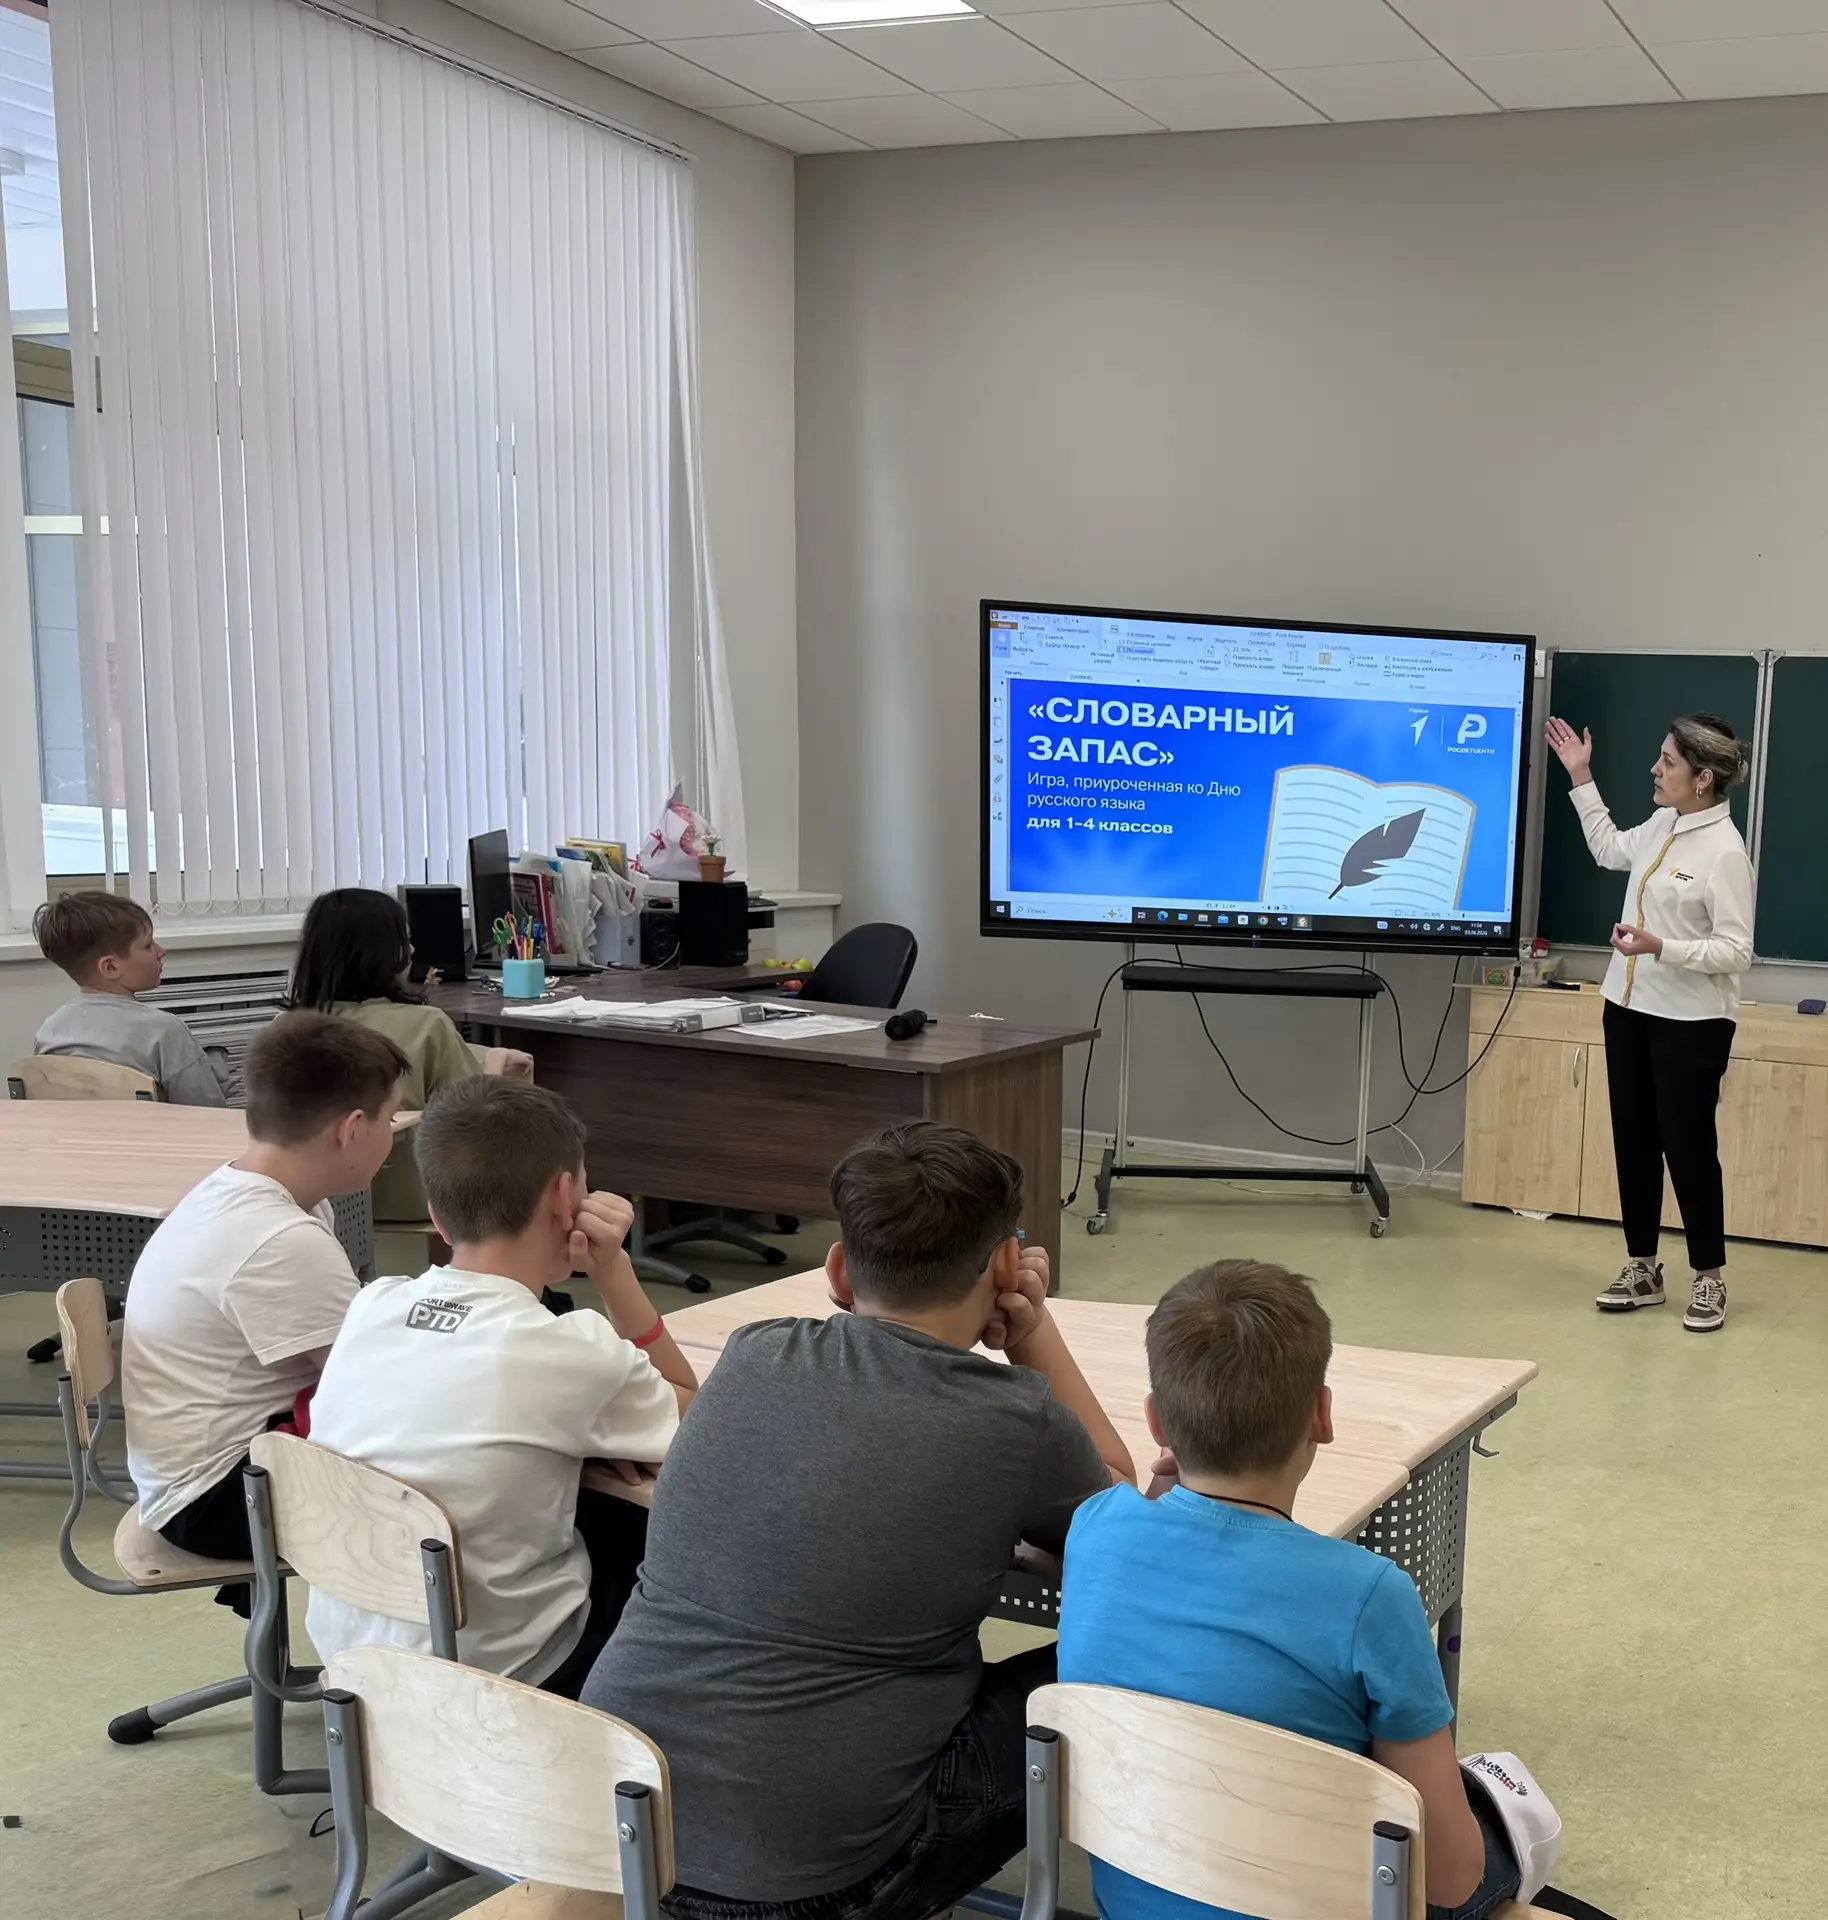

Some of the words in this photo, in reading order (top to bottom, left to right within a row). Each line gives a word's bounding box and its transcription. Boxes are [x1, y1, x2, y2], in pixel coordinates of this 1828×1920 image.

[1028, 696, 1295, 736] «СЛОВАРНЫЙ
[1027, 735, 1175, 767] ЗАПАС»
[1027, 772, 1069, 789] Игра,
[1073, 776, 1183, 793] приуроченная
[1187, 784, 1204, 795] ко
[1206, 781, 1241, 797] Дню
[1027, 793, 1097, 809] русского
[1100, 798, 1146, 811] языка
[1026, 818, 1061, 830] для
[1099, 820, 1173, 834] классов
[410, 1304, 462, 1331] PTD
